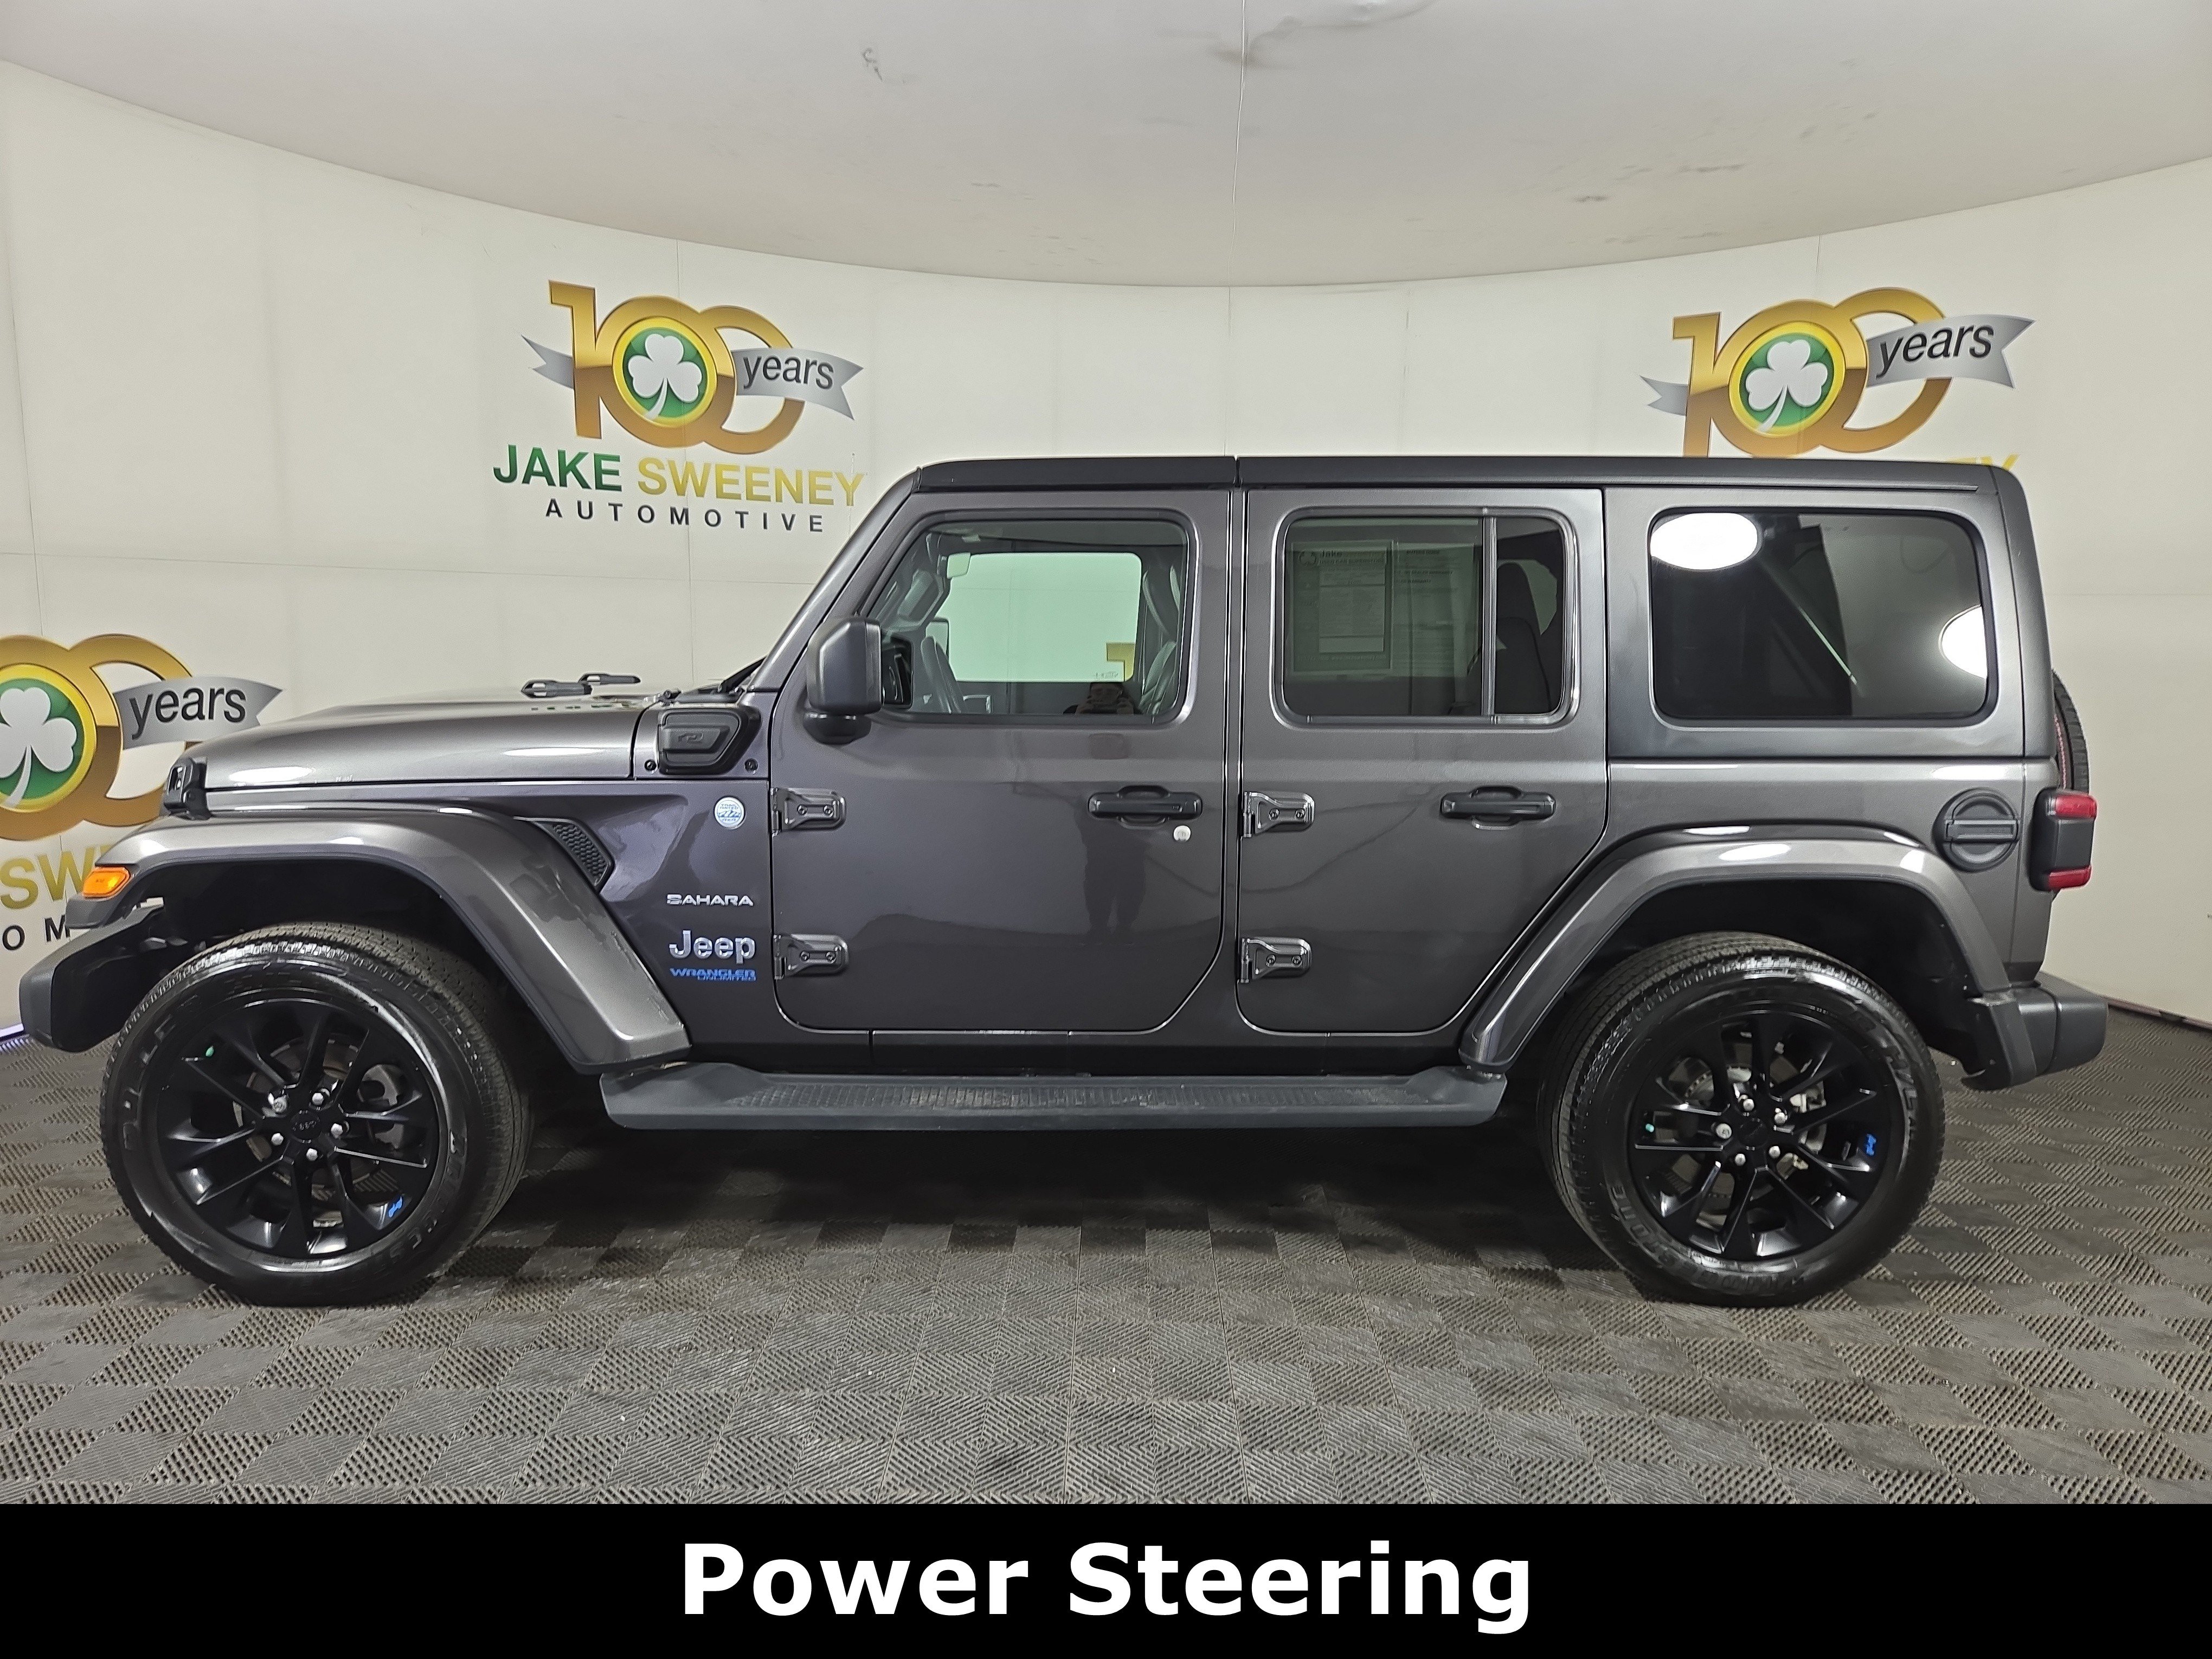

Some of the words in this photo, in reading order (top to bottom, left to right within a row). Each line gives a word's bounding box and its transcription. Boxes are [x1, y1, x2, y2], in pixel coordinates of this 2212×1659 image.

[1876, 324, 1994, 379] years
[743, 353, 834, 390] years
[493, 444, 622, 492] JAKE
[637, 456, 866, 507] SWEENEY
[545, 498, 823, 532] AUTOMOTIVE
[129, 686, 247, 740] years
[667, 894, 754, 906] SAHARA
[669, 930, 755, 964] Jeep
